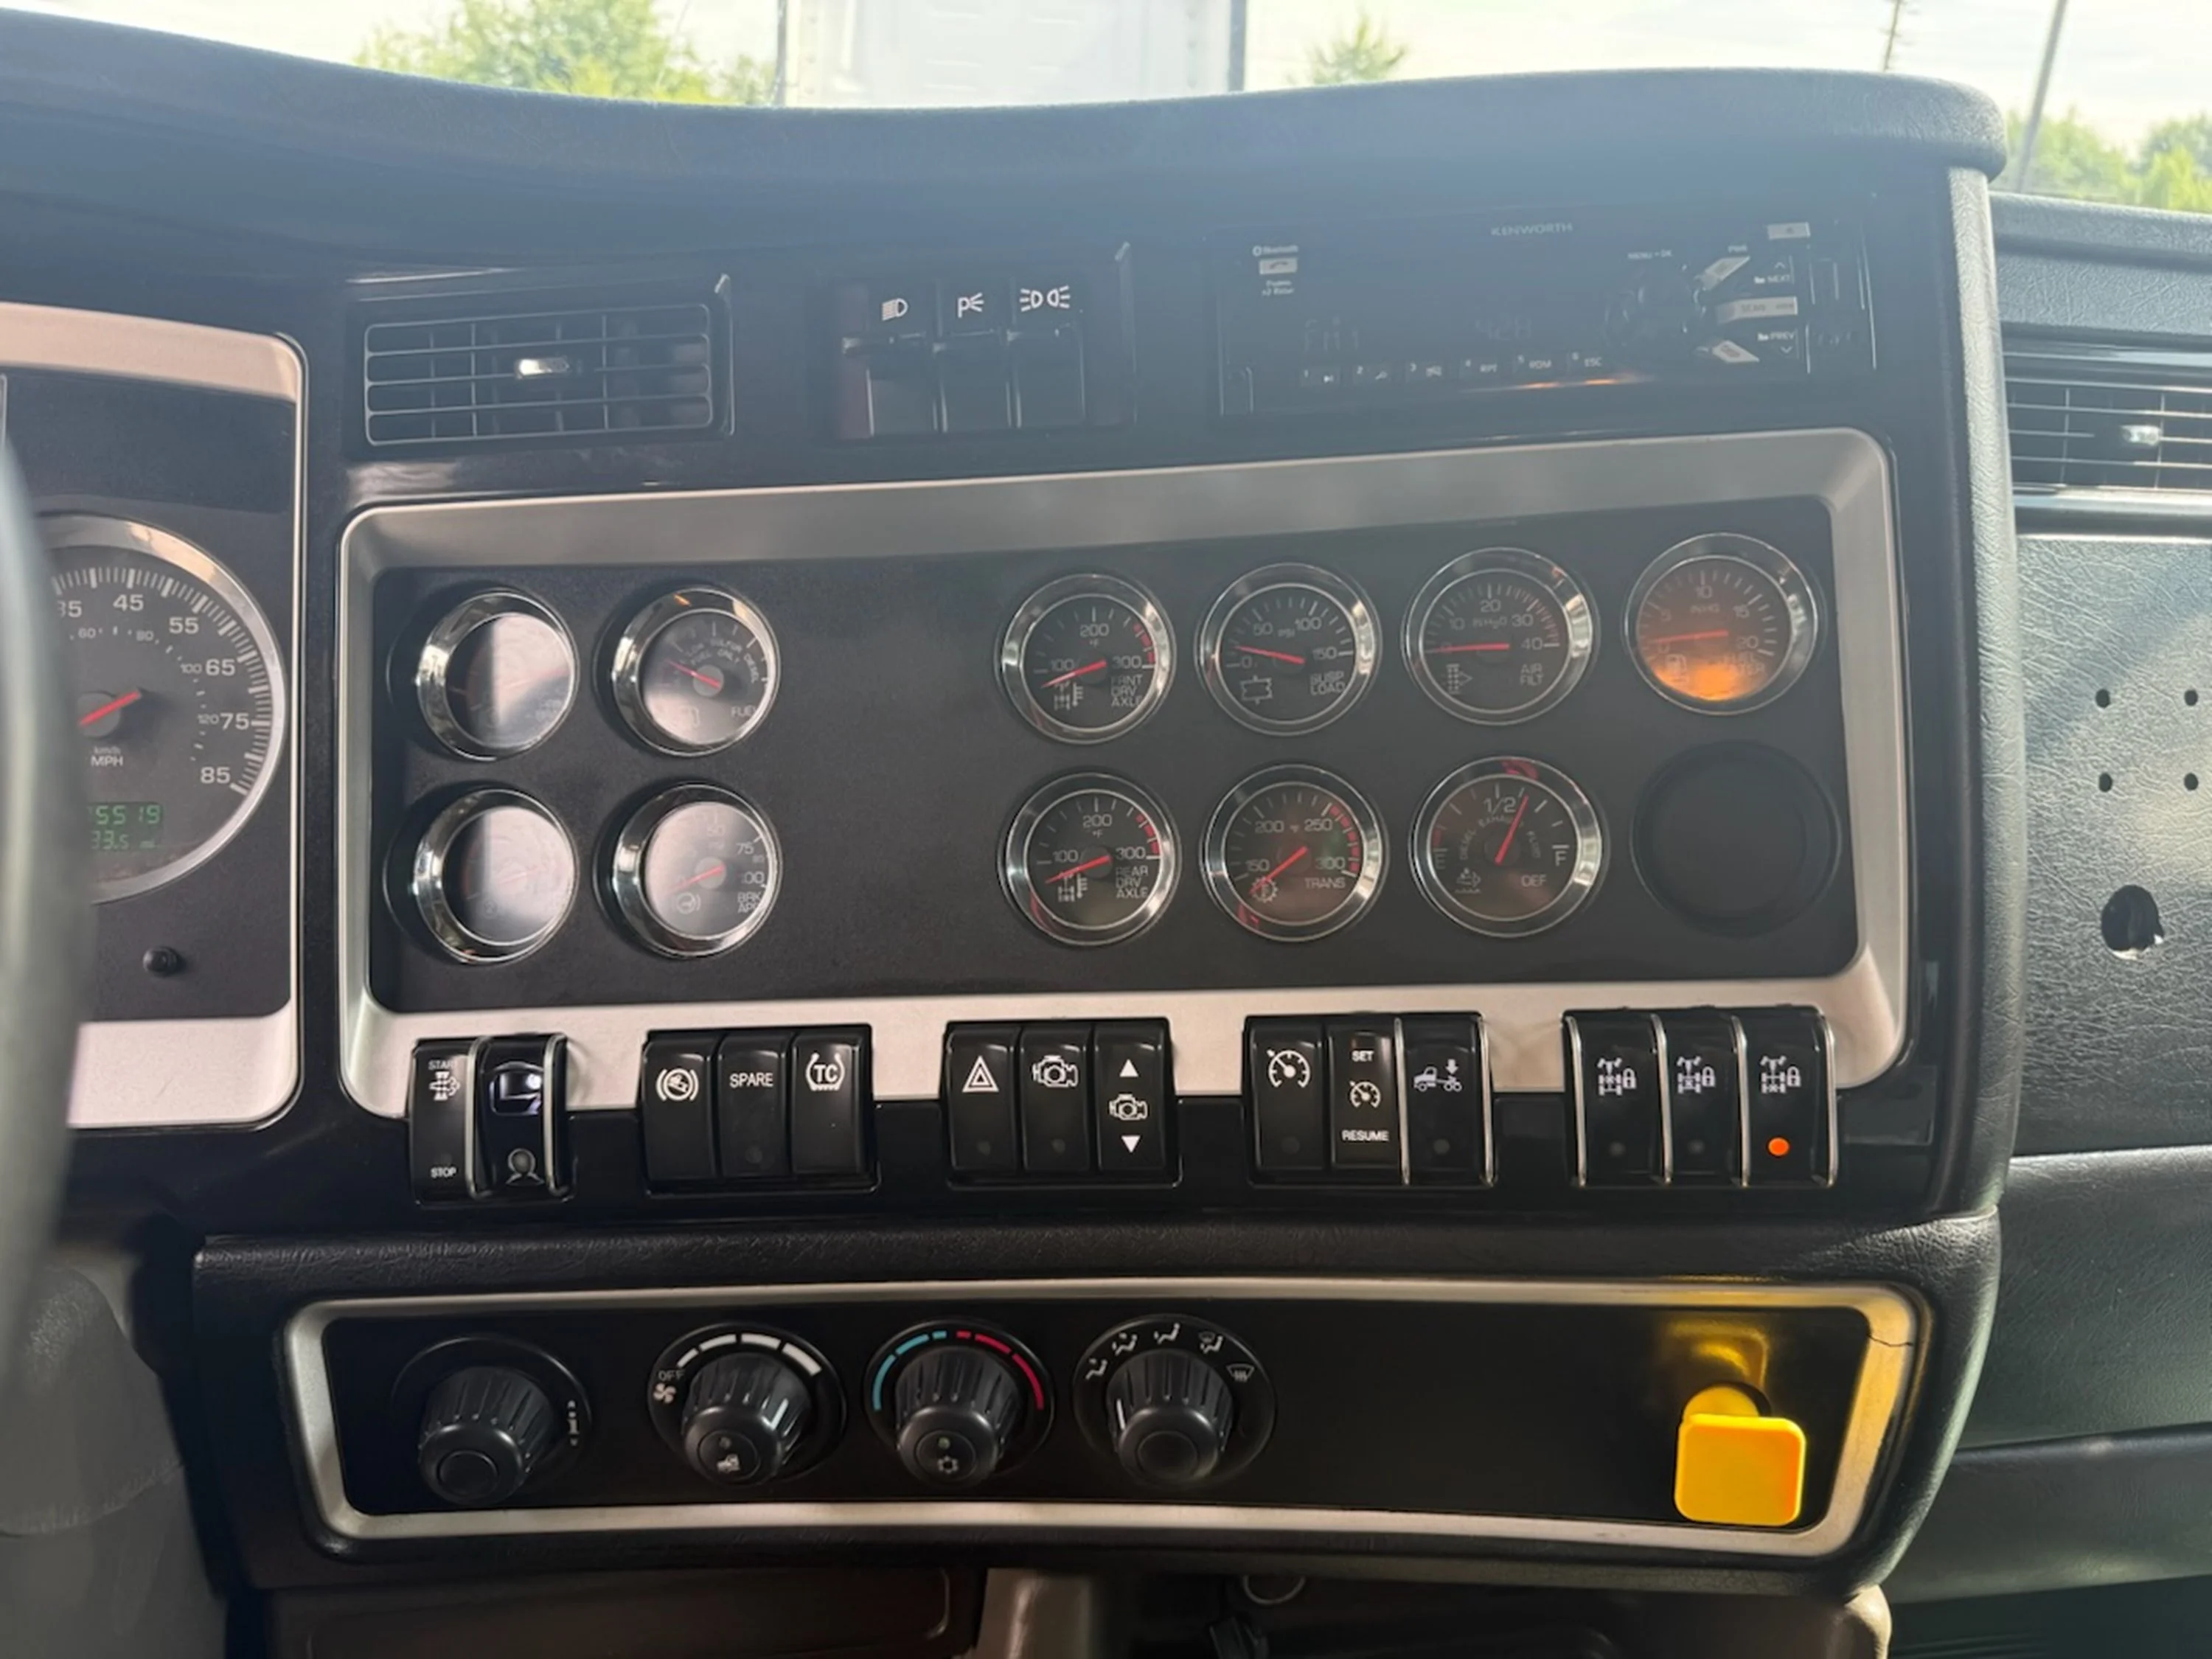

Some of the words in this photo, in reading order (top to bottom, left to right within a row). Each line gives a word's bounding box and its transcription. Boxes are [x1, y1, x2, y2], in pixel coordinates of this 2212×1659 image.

[1490, 223, 1573, 237] KENWORTH
[1584, 356, 1603, 368] ESC
[1694, 585, 1713, 599] 10
[112, 594, 145, 613] 45
[1480, 599, 1502, 613] 20
[1732, 605, 1750, 619] 15
[168, 617, 200, 635] 55
[1295, 616, 1323, 631] 100
[1450, 618, 1465, 630] 10
[1511, 613, 1534, 627] 30
[1079, 622, 1110, 639] 200
[1253, 622, 1273, 636] 50
[1520, 637, 1543, 650] 40
[1736, 636, 1759, 650] 20
[1312, 646, 1338, 661] 150
[180, 663, 203, 675] 100
[205, 658, 236, 677] 65
[1050, 658, 1075, 672] 100
[1112, 655, 1142, 670] 300
[1241, 655, 1253, 669] 0
[1520, 664, 1543, 674] AIR
[1310, 670, 1344, 684] SUSP
[1520, 674, 1544, 686] FILT
[1110, 686, 1137, 696] DRV
[1310, 683, 1346, 695] LOAD
[1110, 696, 1141, 707] AXLE
[220, 712, 250, 731] 75
[91, 755, 124, 768] MPH
[200, 766, 232, 785] 85
[1482, 796, 1516, 815] 1/2
[1082, 813, 1113, 829] 200
[1255, 820, 1285, 834] 200
[1304, 818, 1333, 832] 250
[736, 842, 754, 855] 75
[1116, 846, 1146, 860] 300
[1052, 849, 1079, 863] 100
[1315, 856, 1346, 870] 300
[1434, 853, 1446, 870] E
[1555, 850, 1567, 867] F
[1116, 866, 1149, 877] REAR
[1245, 858, 1270, 872] 150
[740, 871, 765, 884] 00
[1116, 877, 1141, 888] DRV
[1304, 877, 1346, 889] TRANS
[1116, 888, 1148, 899] AXLE
[1351, 1050, 1375, 1062] SET
[728, 1071, 773, 1089] SPARE
[814, 1063, 838, 1083] TC
[1341, 1129, 1390, 1143] RESUME
[430, 1166, 457, 1179] STOP
[658, 1369, 686, 1382] OFF
